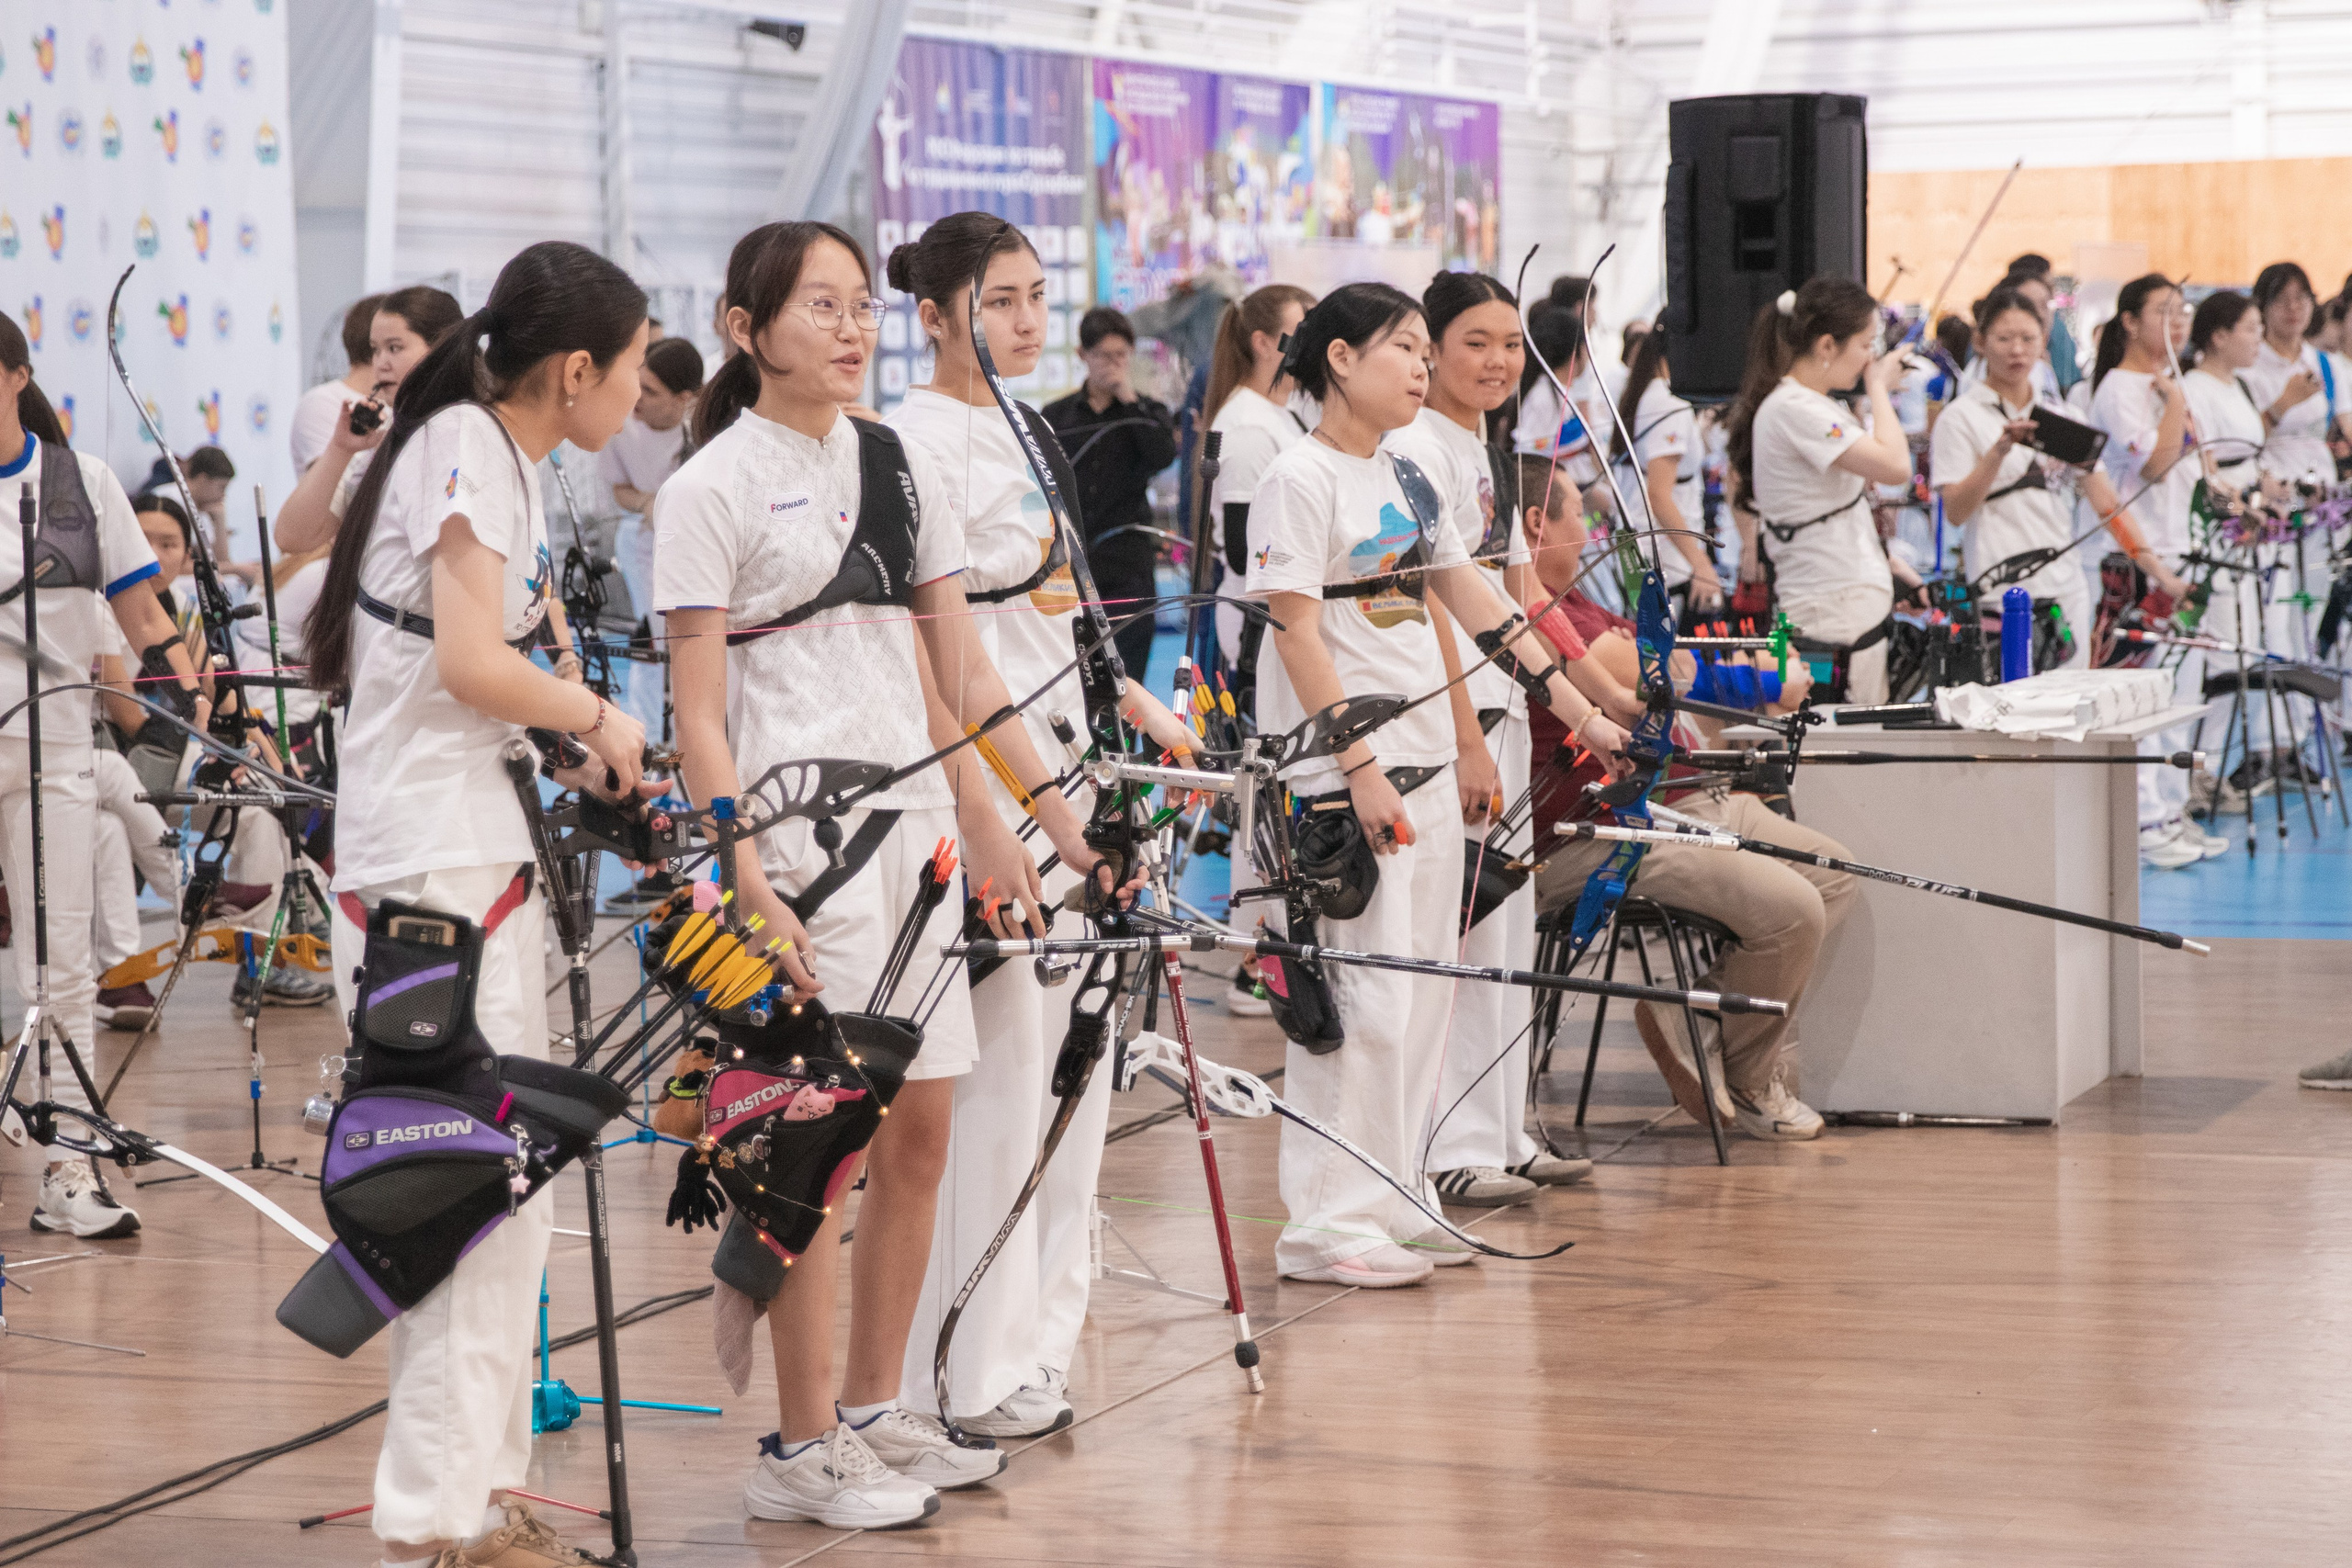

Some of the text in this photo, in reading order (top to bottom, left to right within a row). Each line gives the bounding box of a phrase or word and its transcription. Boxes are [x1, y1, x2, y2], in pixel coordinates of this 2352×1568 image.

[770, 498, 808, 513] FORWARD
[861, 542, 892, 596] ARCHERY
[1905, 876, 1964, 898] PLUS
[727, 1078, 794, 1119] EASTON
[377, 1119, 472, 1145] EASTON
[954, 1212, 1022, 1309] WIAWIS
